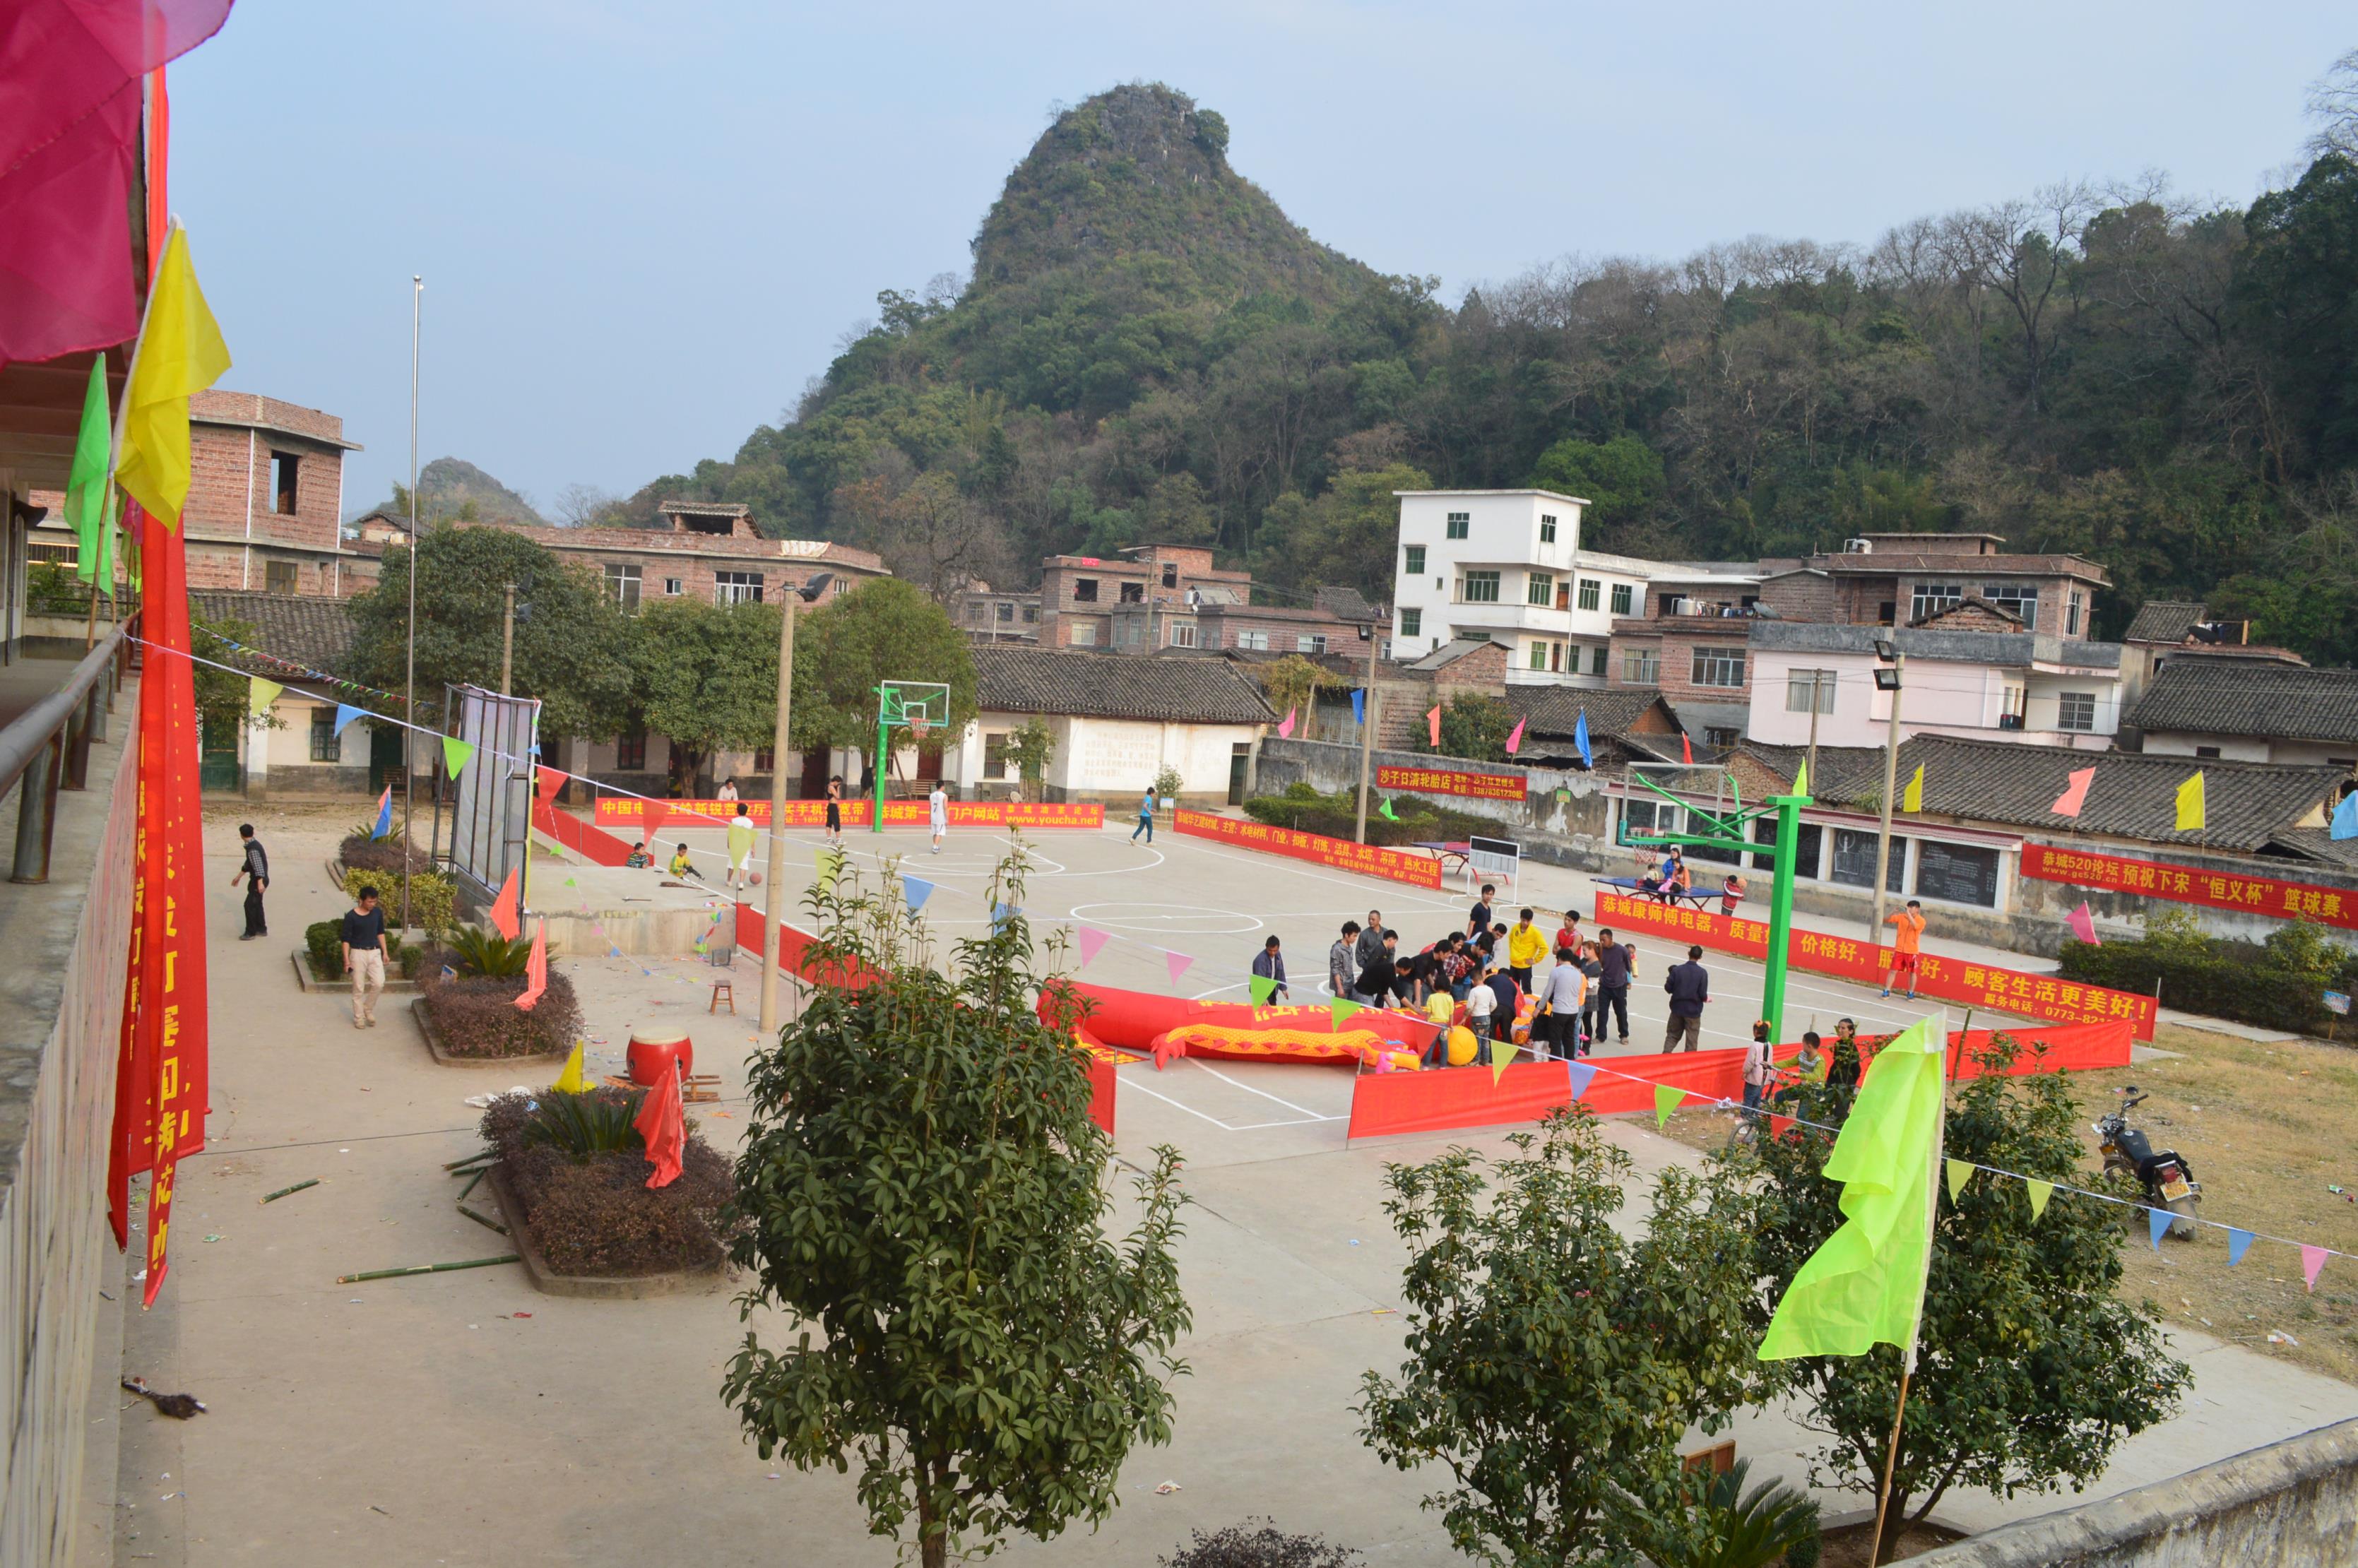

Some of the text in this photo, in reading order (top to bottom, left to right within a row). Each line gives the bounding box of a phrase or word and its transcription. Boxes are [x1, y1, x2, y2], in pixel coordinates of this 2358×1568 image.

[1006, 814, 1098, 826] www.youcha.net
[2043, 852, 2119, 876] 恭城520论坛
[2042, 867, 2117, 883] www.gc520.cn
